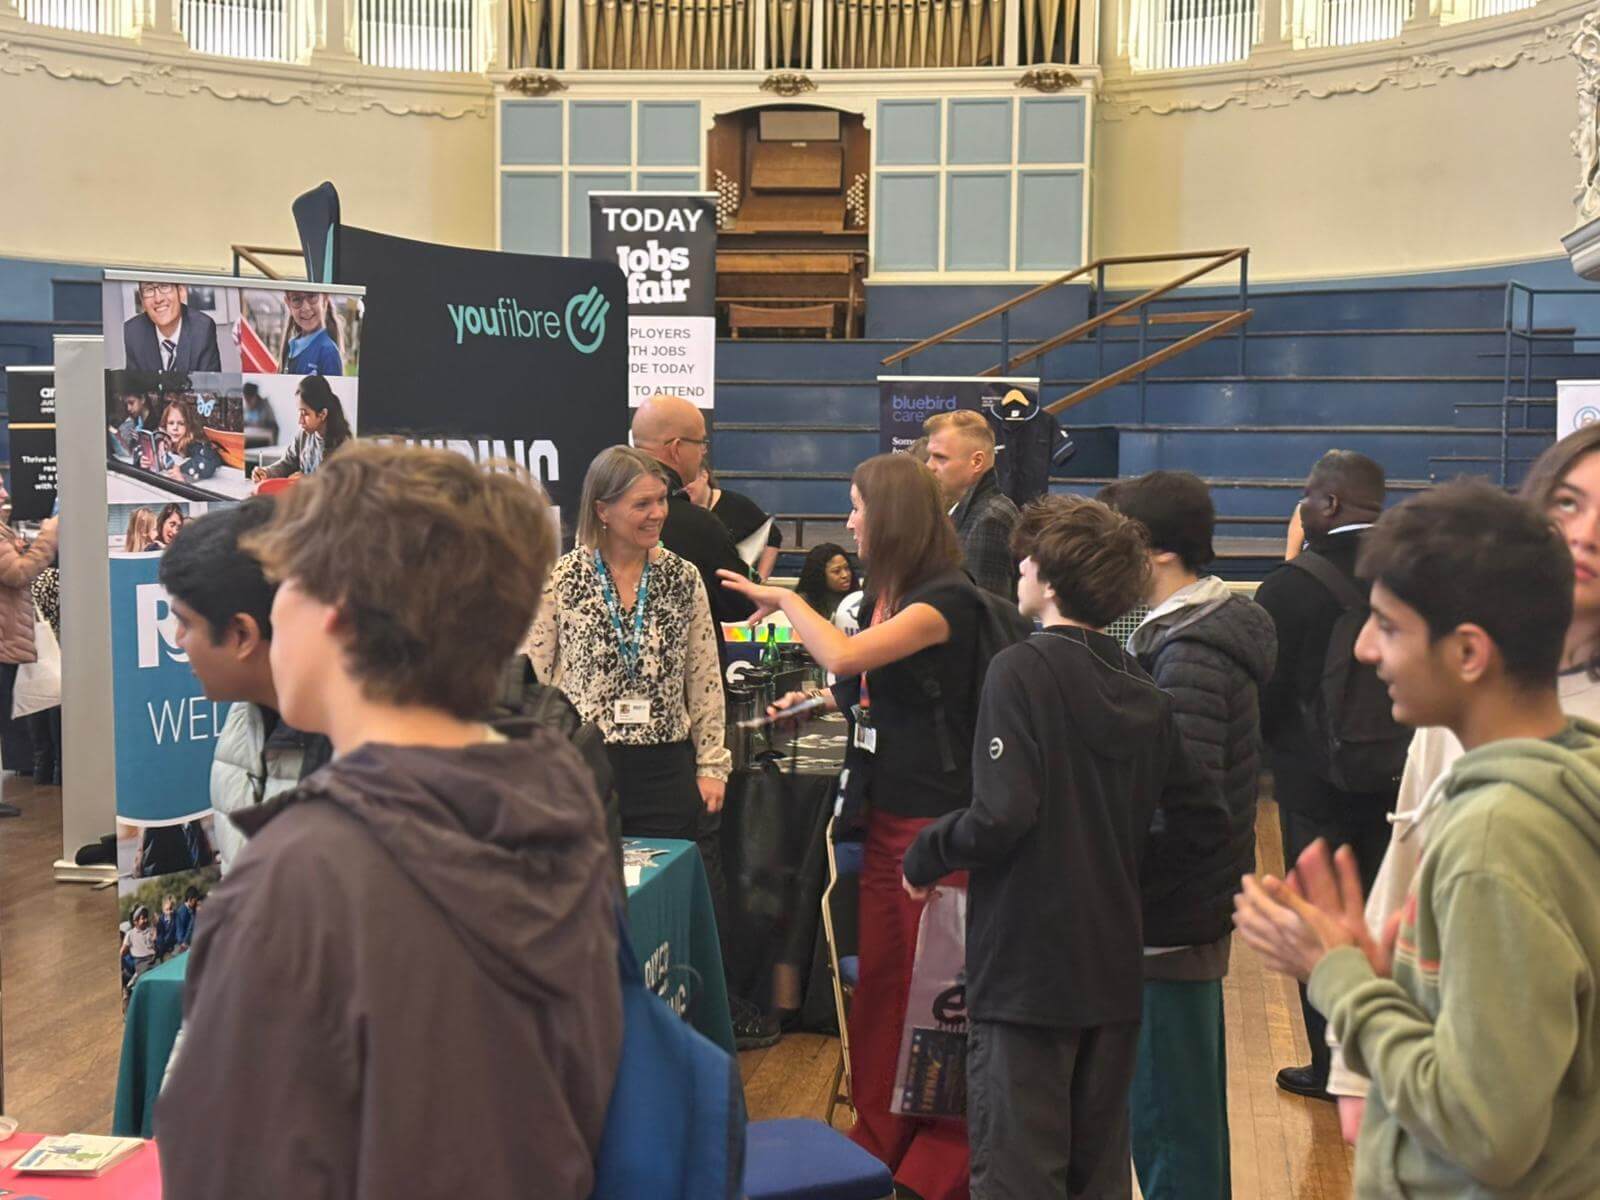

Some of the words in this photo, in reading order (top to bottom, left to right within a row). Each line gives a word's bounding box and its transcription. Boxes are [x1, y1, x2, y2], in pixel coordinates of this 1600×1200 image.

[602, 208, 703, 232] TODAY
[627, 271, 691, 304] fair
[447, 298, 561, 344] youfibre
[630, 328, 691, 339] PLOYERS
[651, 346, 687, 357] JOBS
[631, 363, 648, 373] DE
[652, 364, 695, 374] TODAY
[634, 386, 651, 395] TO
[654, 387, 705, 397] ATTEND
[892, 395, 957, 410] bluebird
[892, 411, 925, 422] care
